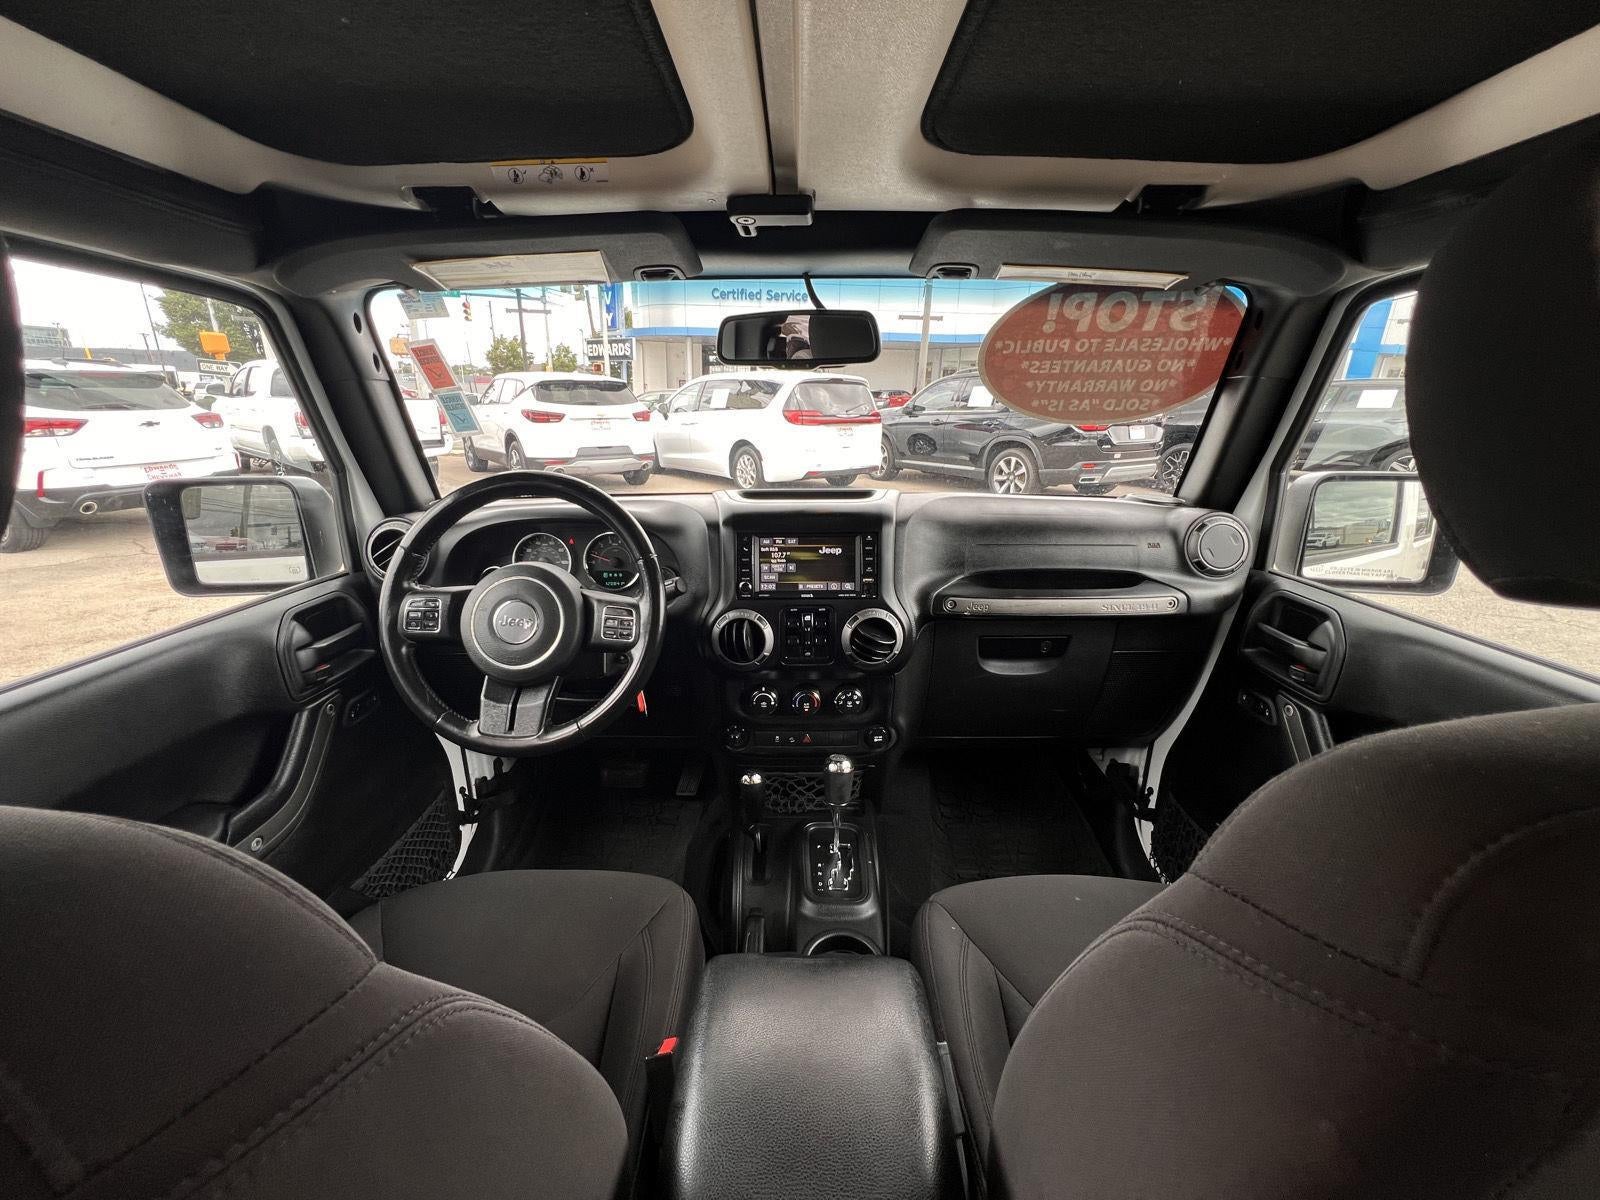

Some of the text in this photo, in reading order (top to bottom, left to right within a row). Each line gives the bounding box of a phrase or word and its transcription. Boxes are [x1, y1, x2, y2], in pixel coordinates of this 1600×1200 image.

[711, 288, 808, 302] Certified Service
[587, 342, 631, 356] EDWARDS
[818, 546, 842, 556] Jeep
[966, 601, 990, 612] Jeep
[498, 614, 534, 628] Jeep
